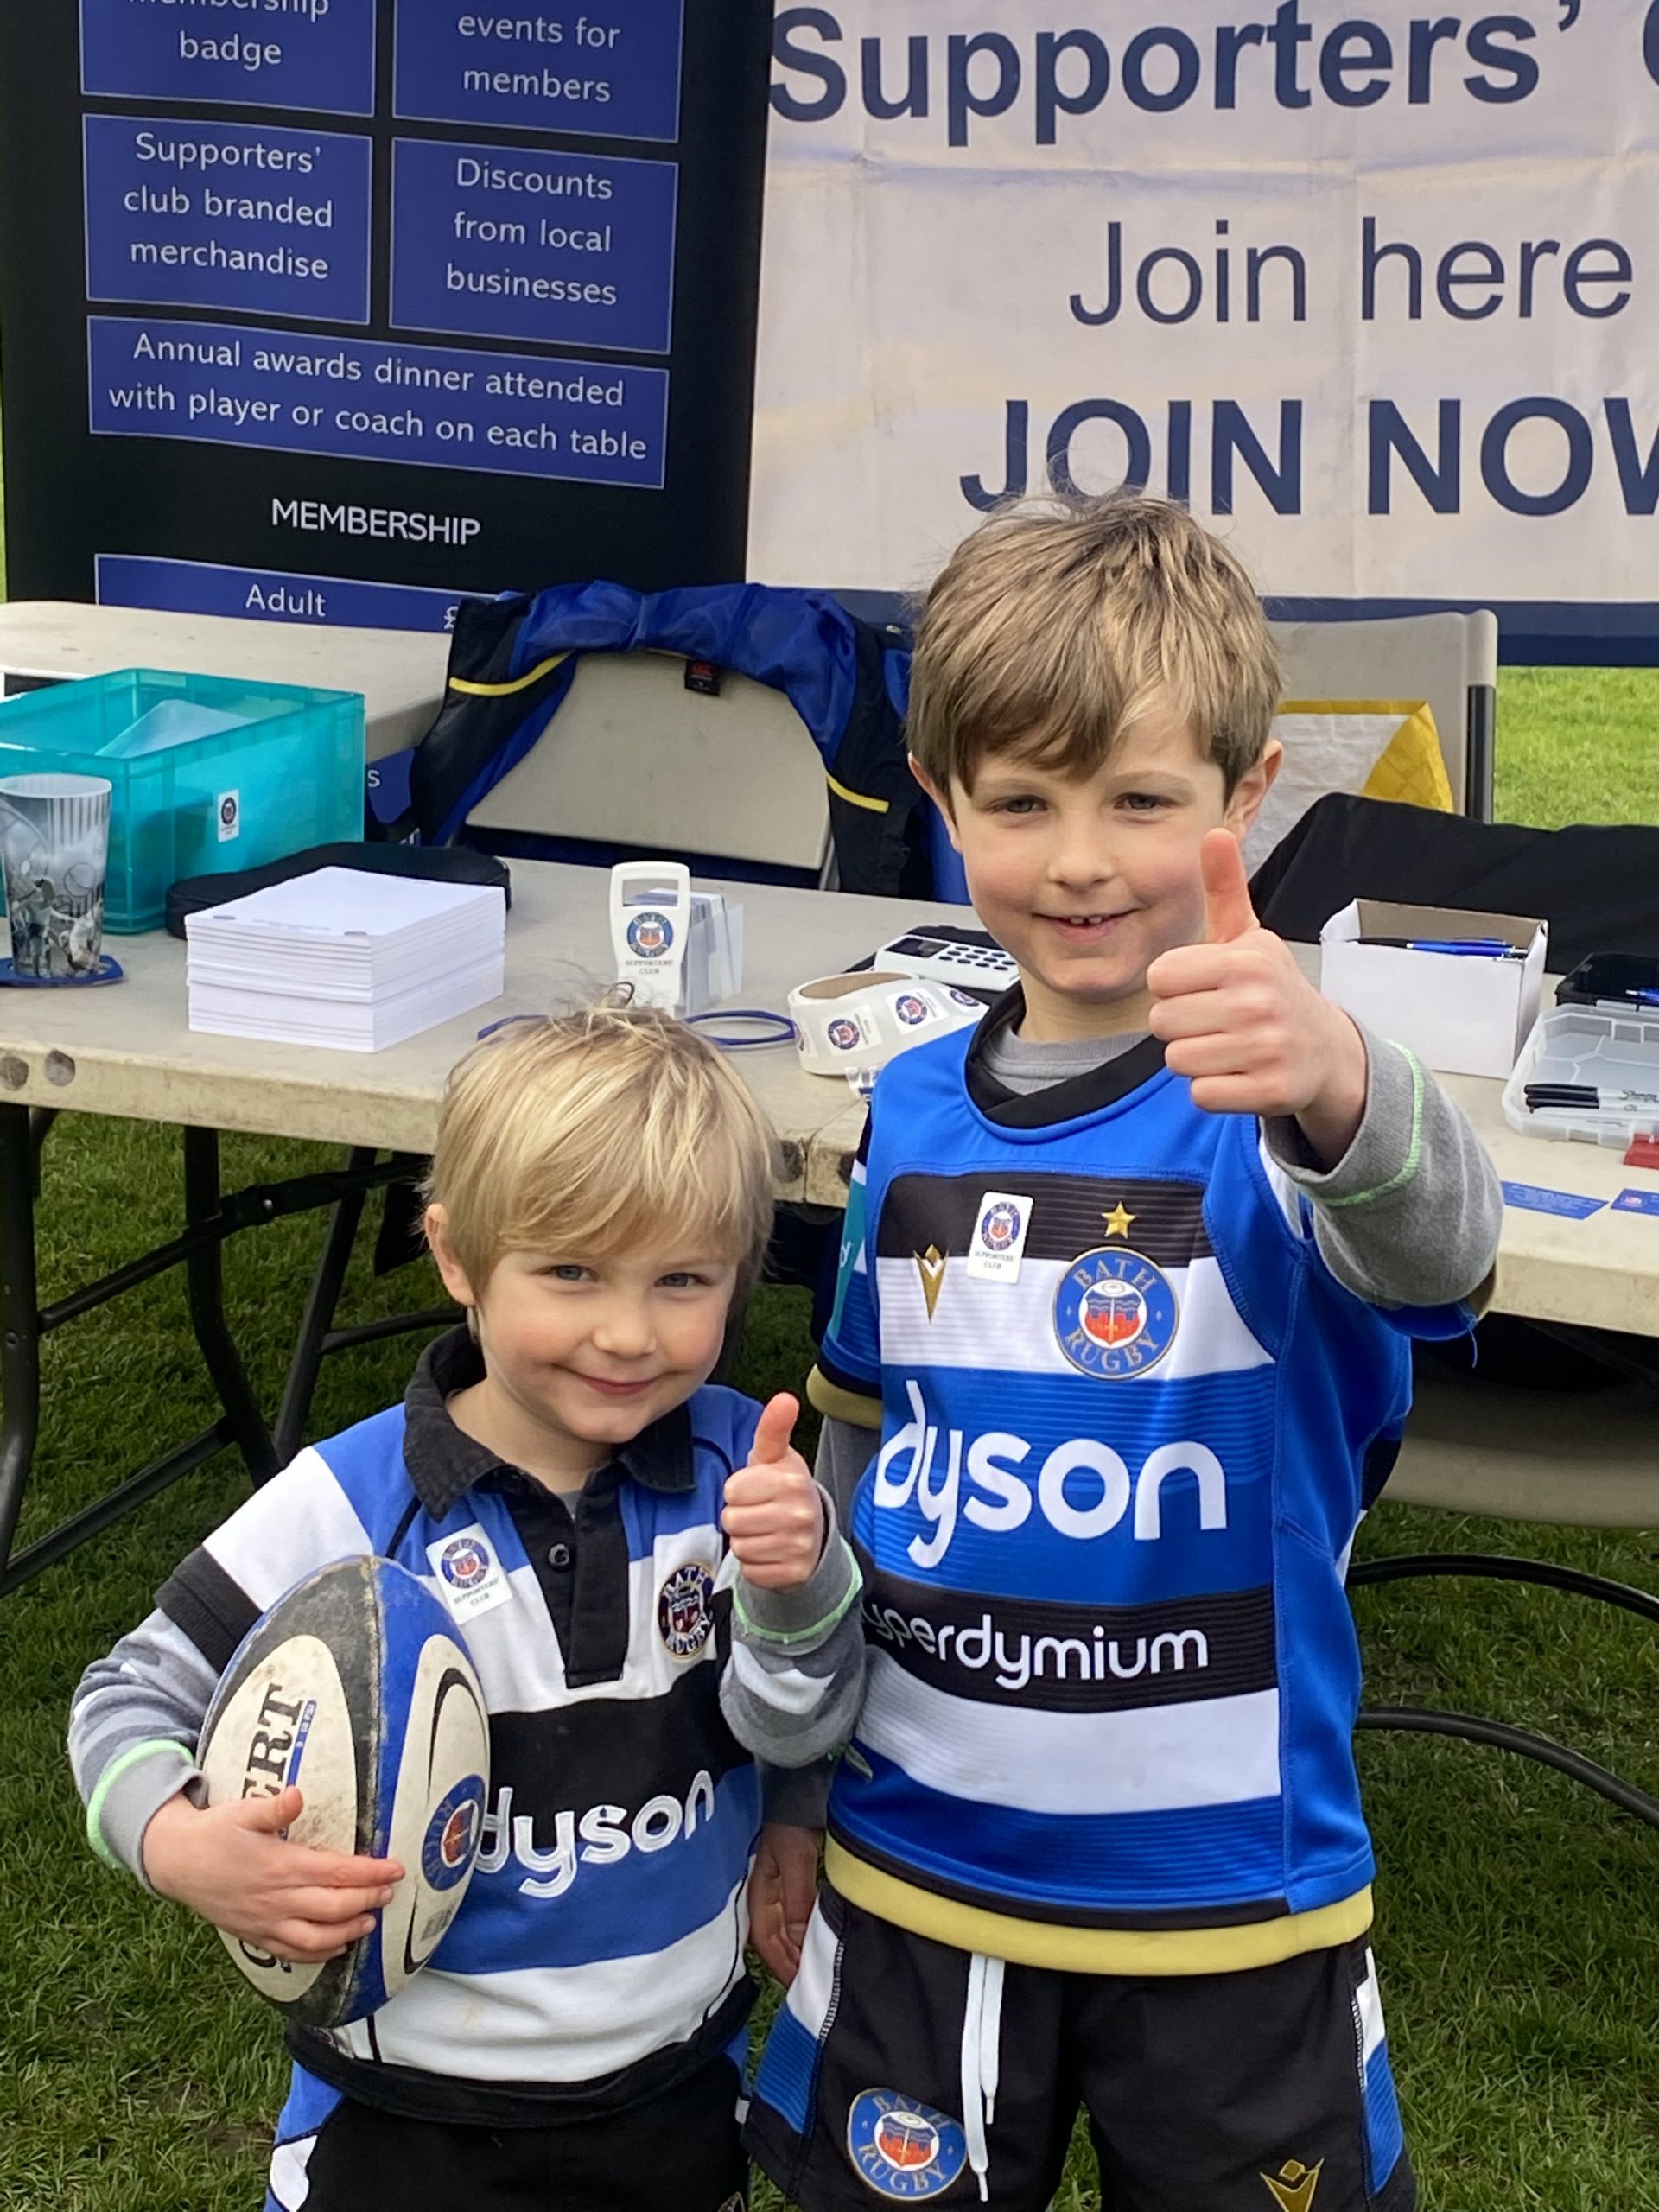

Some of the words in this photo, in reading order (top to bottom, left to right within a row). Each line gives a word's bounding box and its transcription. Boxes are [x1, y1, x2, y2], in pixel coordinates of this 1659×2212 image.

[179, 30, 282, 71] badge
[457, 15, 563, 44] events
[575, 17, 620, 48] for
[463, 68, 611, 103] members
[456, 157, 613, 200] Discounts
[124, 184, 190, 214] club
[204, 188, 333, 228] branded
[454, 211, 525, 245] from
[540, 219, 611, 252] local
[130, 239, 328, 279] merchandise
[1069, 219, 1307, 327] Join
[1360, 215, 1633, 321] here
[447, 262, 617, 306] businesses
[133, 332, 241, 367] Annual
[253, 349, 362, 381] awards
[374, 357, 474, 391] dinner
[485, 372, 624, 407] attended
[109, 381, 175, 411] with
[188, 388, 281, 426] player
[292, 404, 324, 427] or
[335, 409, 423, 437] coach
[435, 420, 474, 442] on
[486, 423, 557, 450] each
[570, 429, 647, 460] table
[959, 398, 1302, 516] JOIN
[271, 498, 480, 546] MEMBERSHIP
[245, 583, 327, 617] Adult
[1071, 1258, 1157, 1294] BATH
[1065, 1328, 1159, 1371] RUGBY
[874, 1379, 1228, 1569] dyson
[662, 1566, 706, 1604] BATH
[665, 1611, 711, 1654] RUGBY
[475, 1770, 715, 1898] dyson
[858, 2144, 948, 2191] RUGBY
